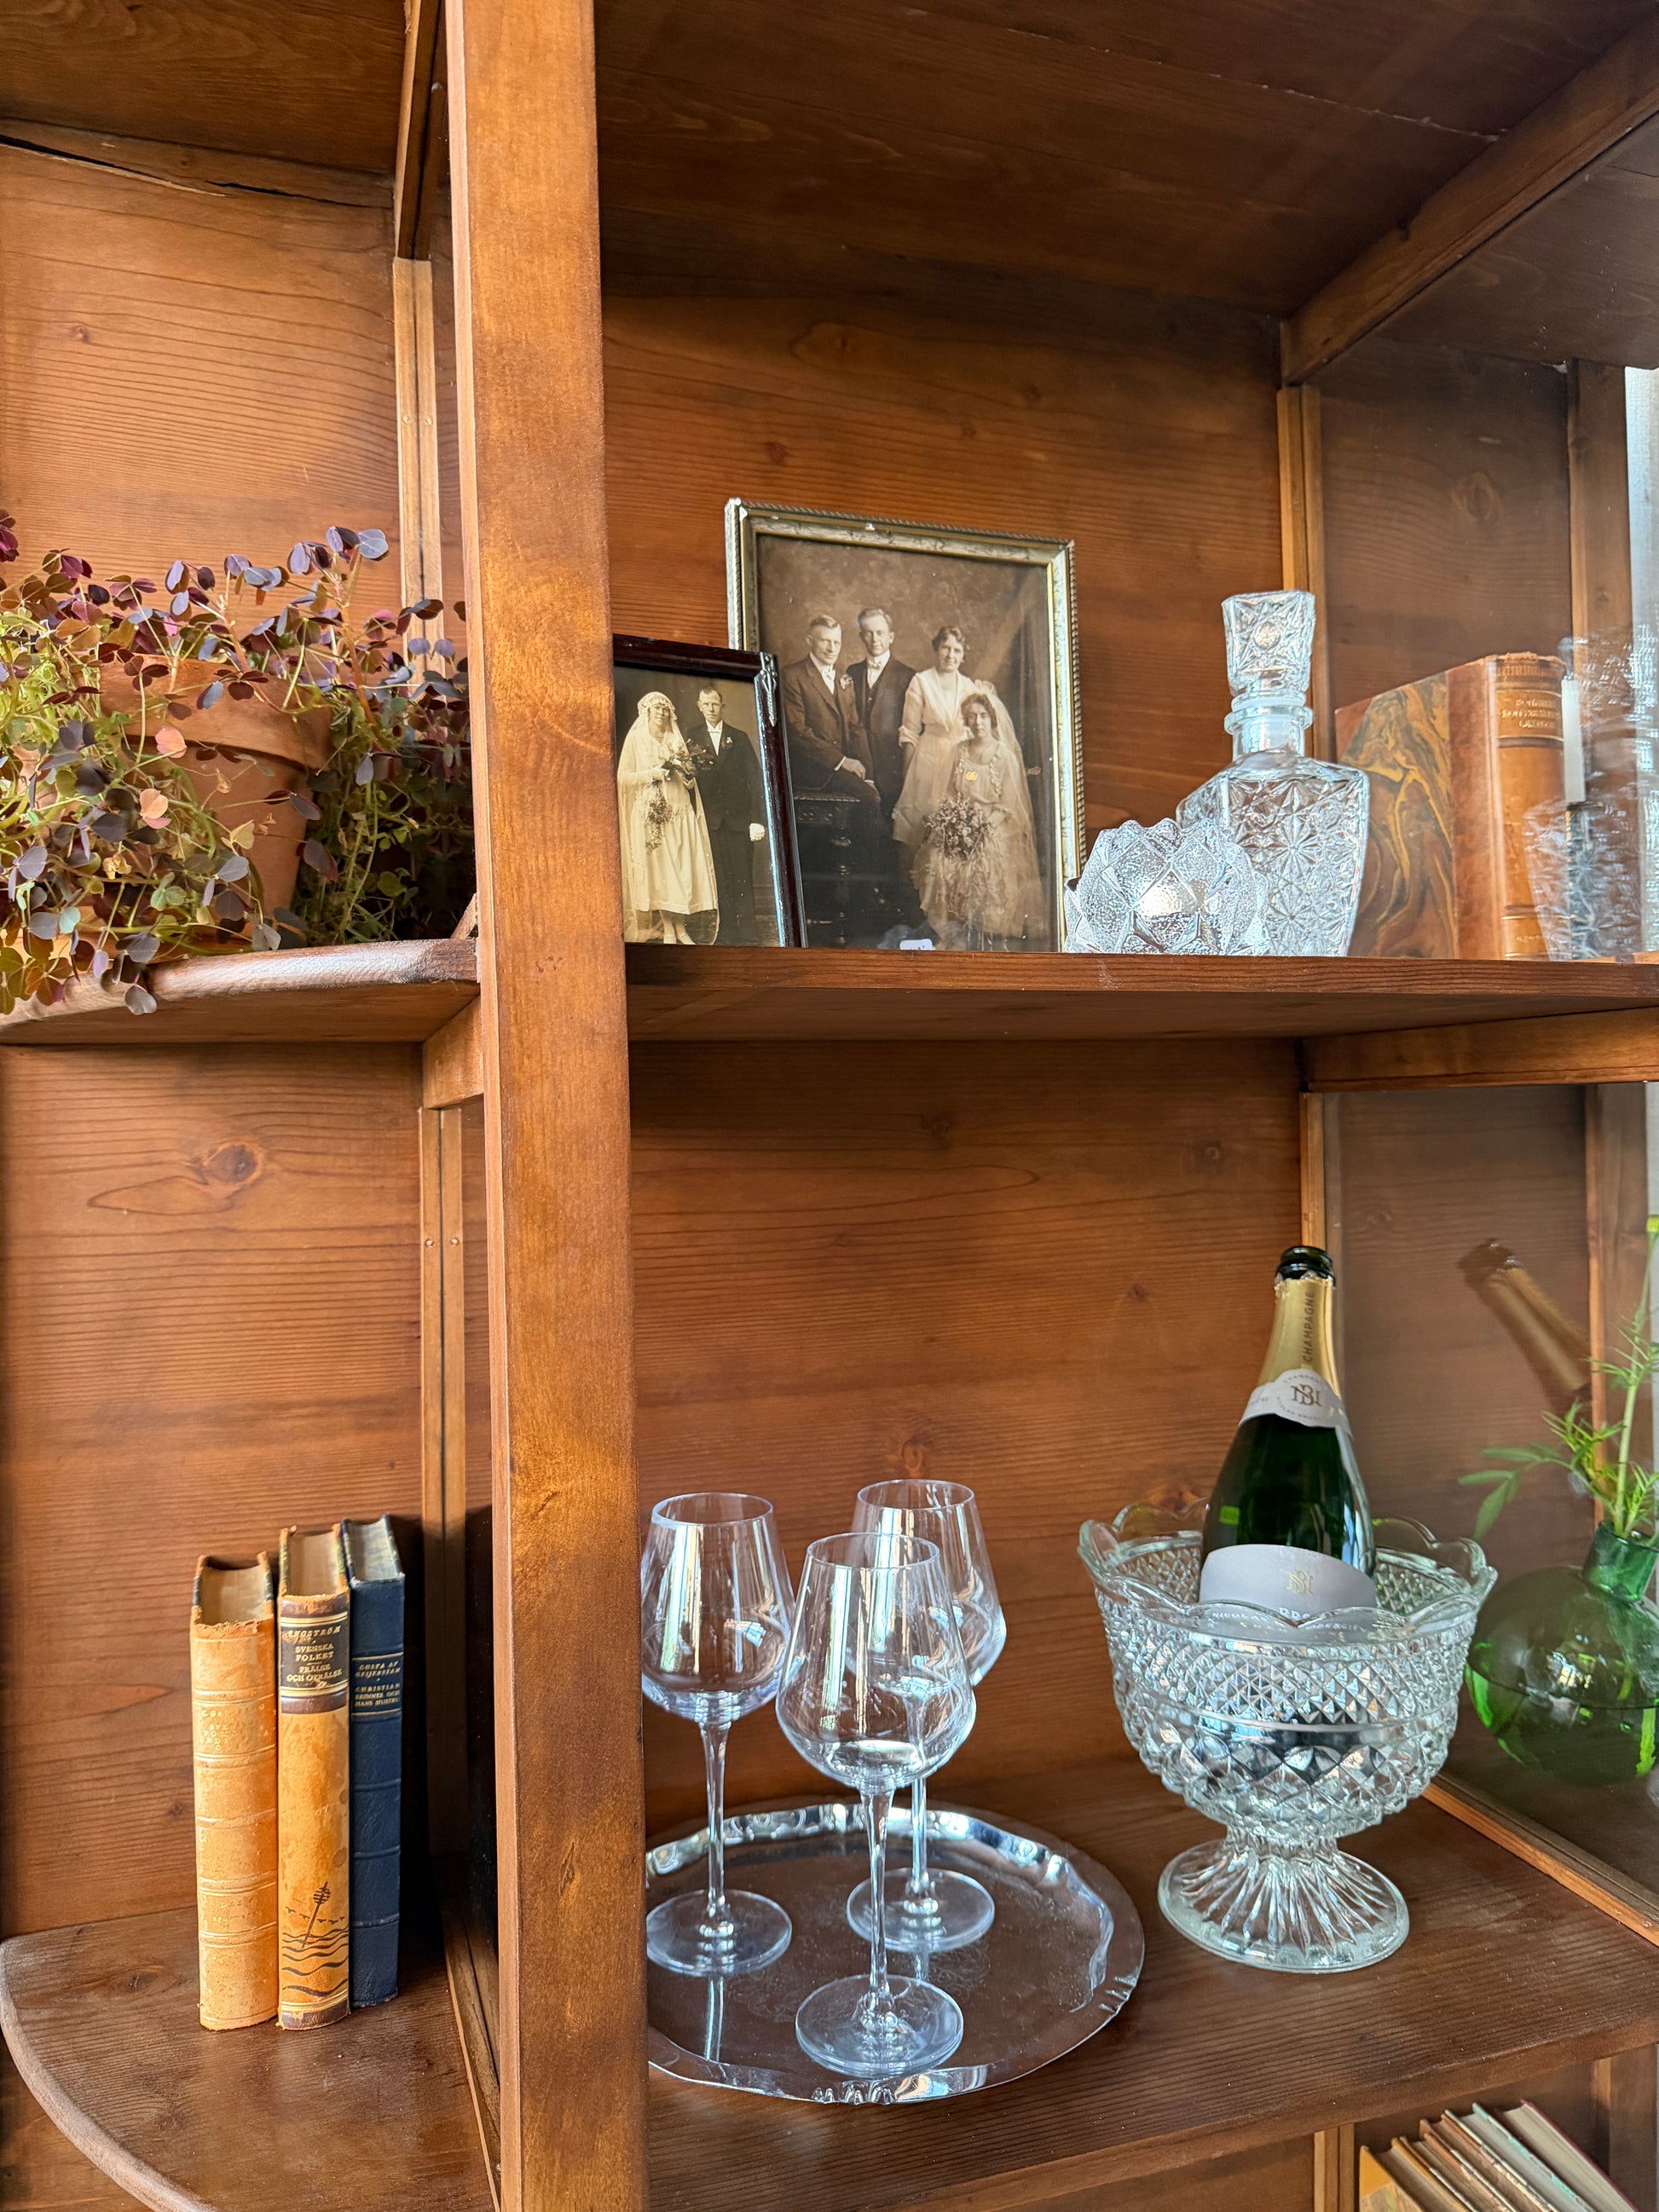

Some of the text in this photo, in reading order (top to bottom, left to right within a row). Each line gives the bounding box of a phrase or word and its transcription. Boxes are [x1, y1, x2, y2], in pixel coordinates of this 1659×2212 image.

[1302, 1291, 1315, 1363] CHAMPAGNE
[294, 1643, 334, 1654] SVENSKA
[294, 1651, 334, 1662] FOLKET
[286, 1673, 305, 1682] OCH
